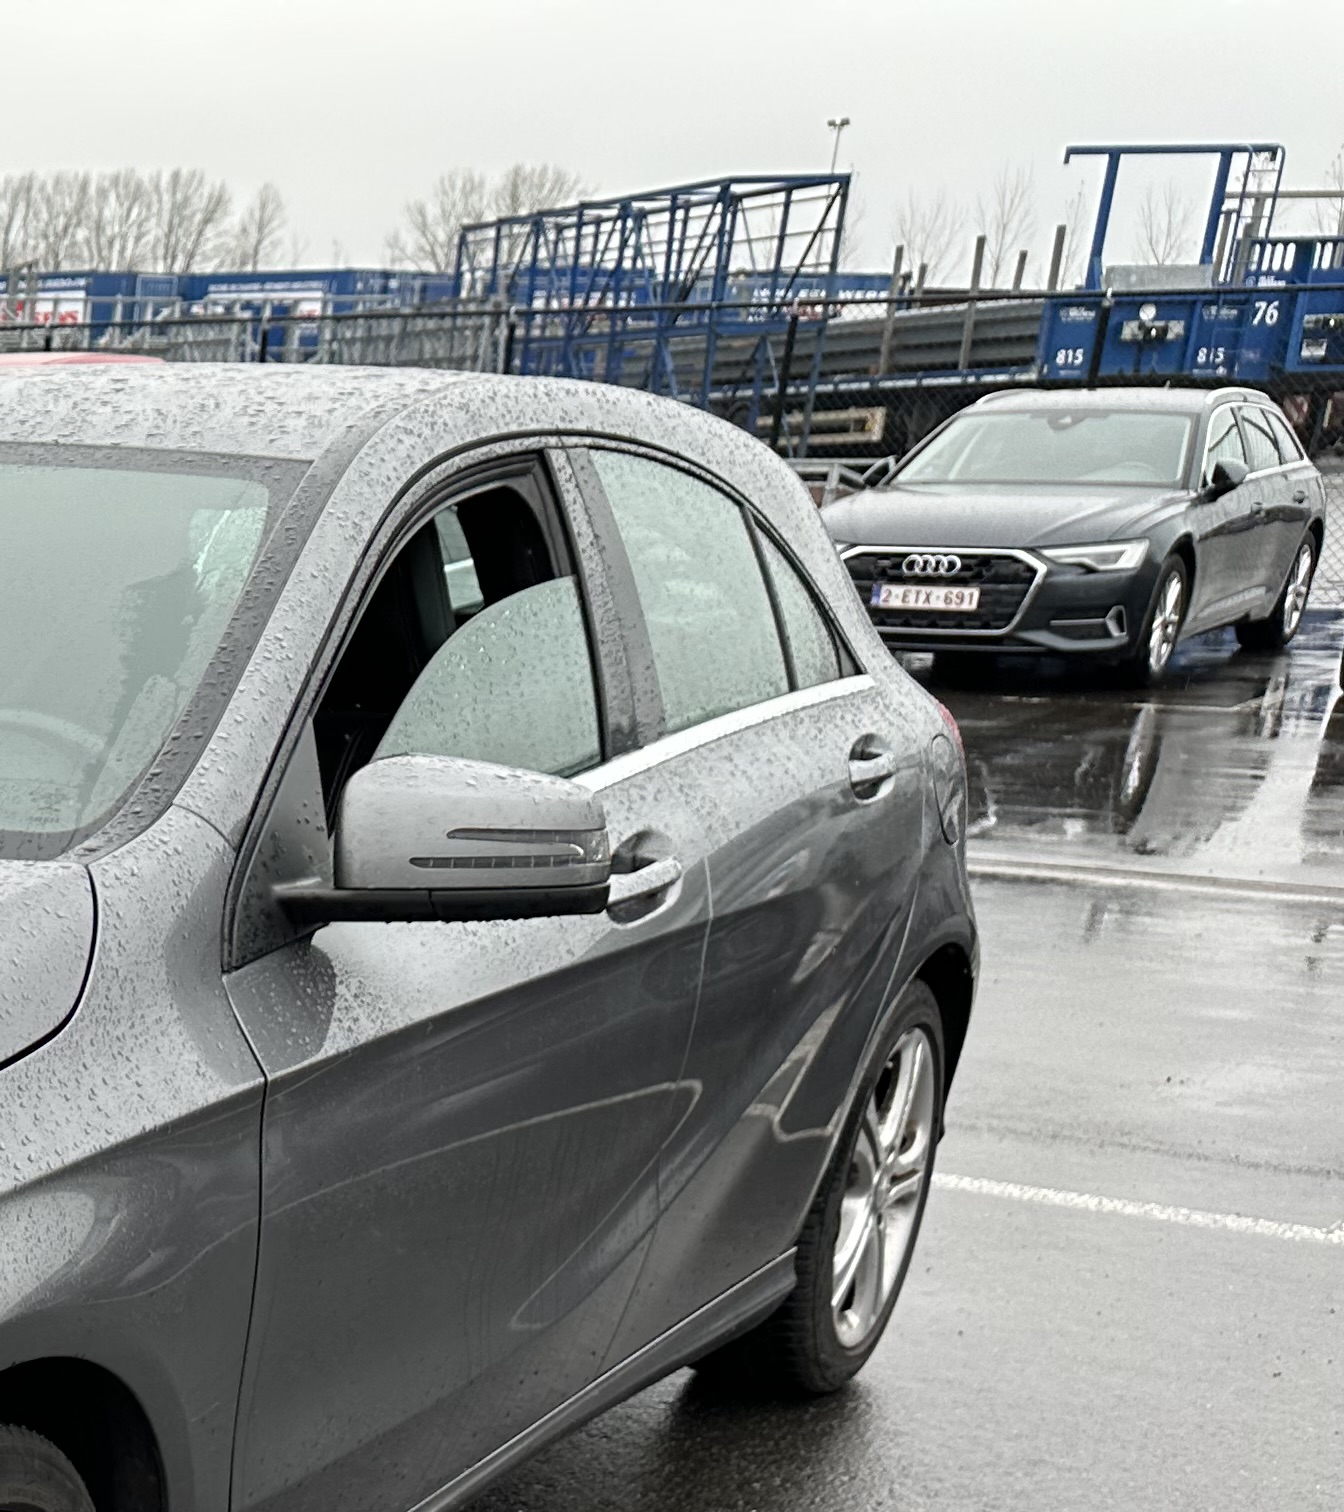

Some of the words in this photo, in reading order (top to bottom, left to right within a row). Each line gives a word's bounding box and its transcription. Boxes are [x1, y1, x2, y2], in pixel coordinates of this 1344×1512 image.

[1251, 301, 1280, 326] 76
[1055, 348, 1084, 366] 815
[1196, 347, 1226, 364] 815
[882, 588, 975, 606] 2-ETX-691
